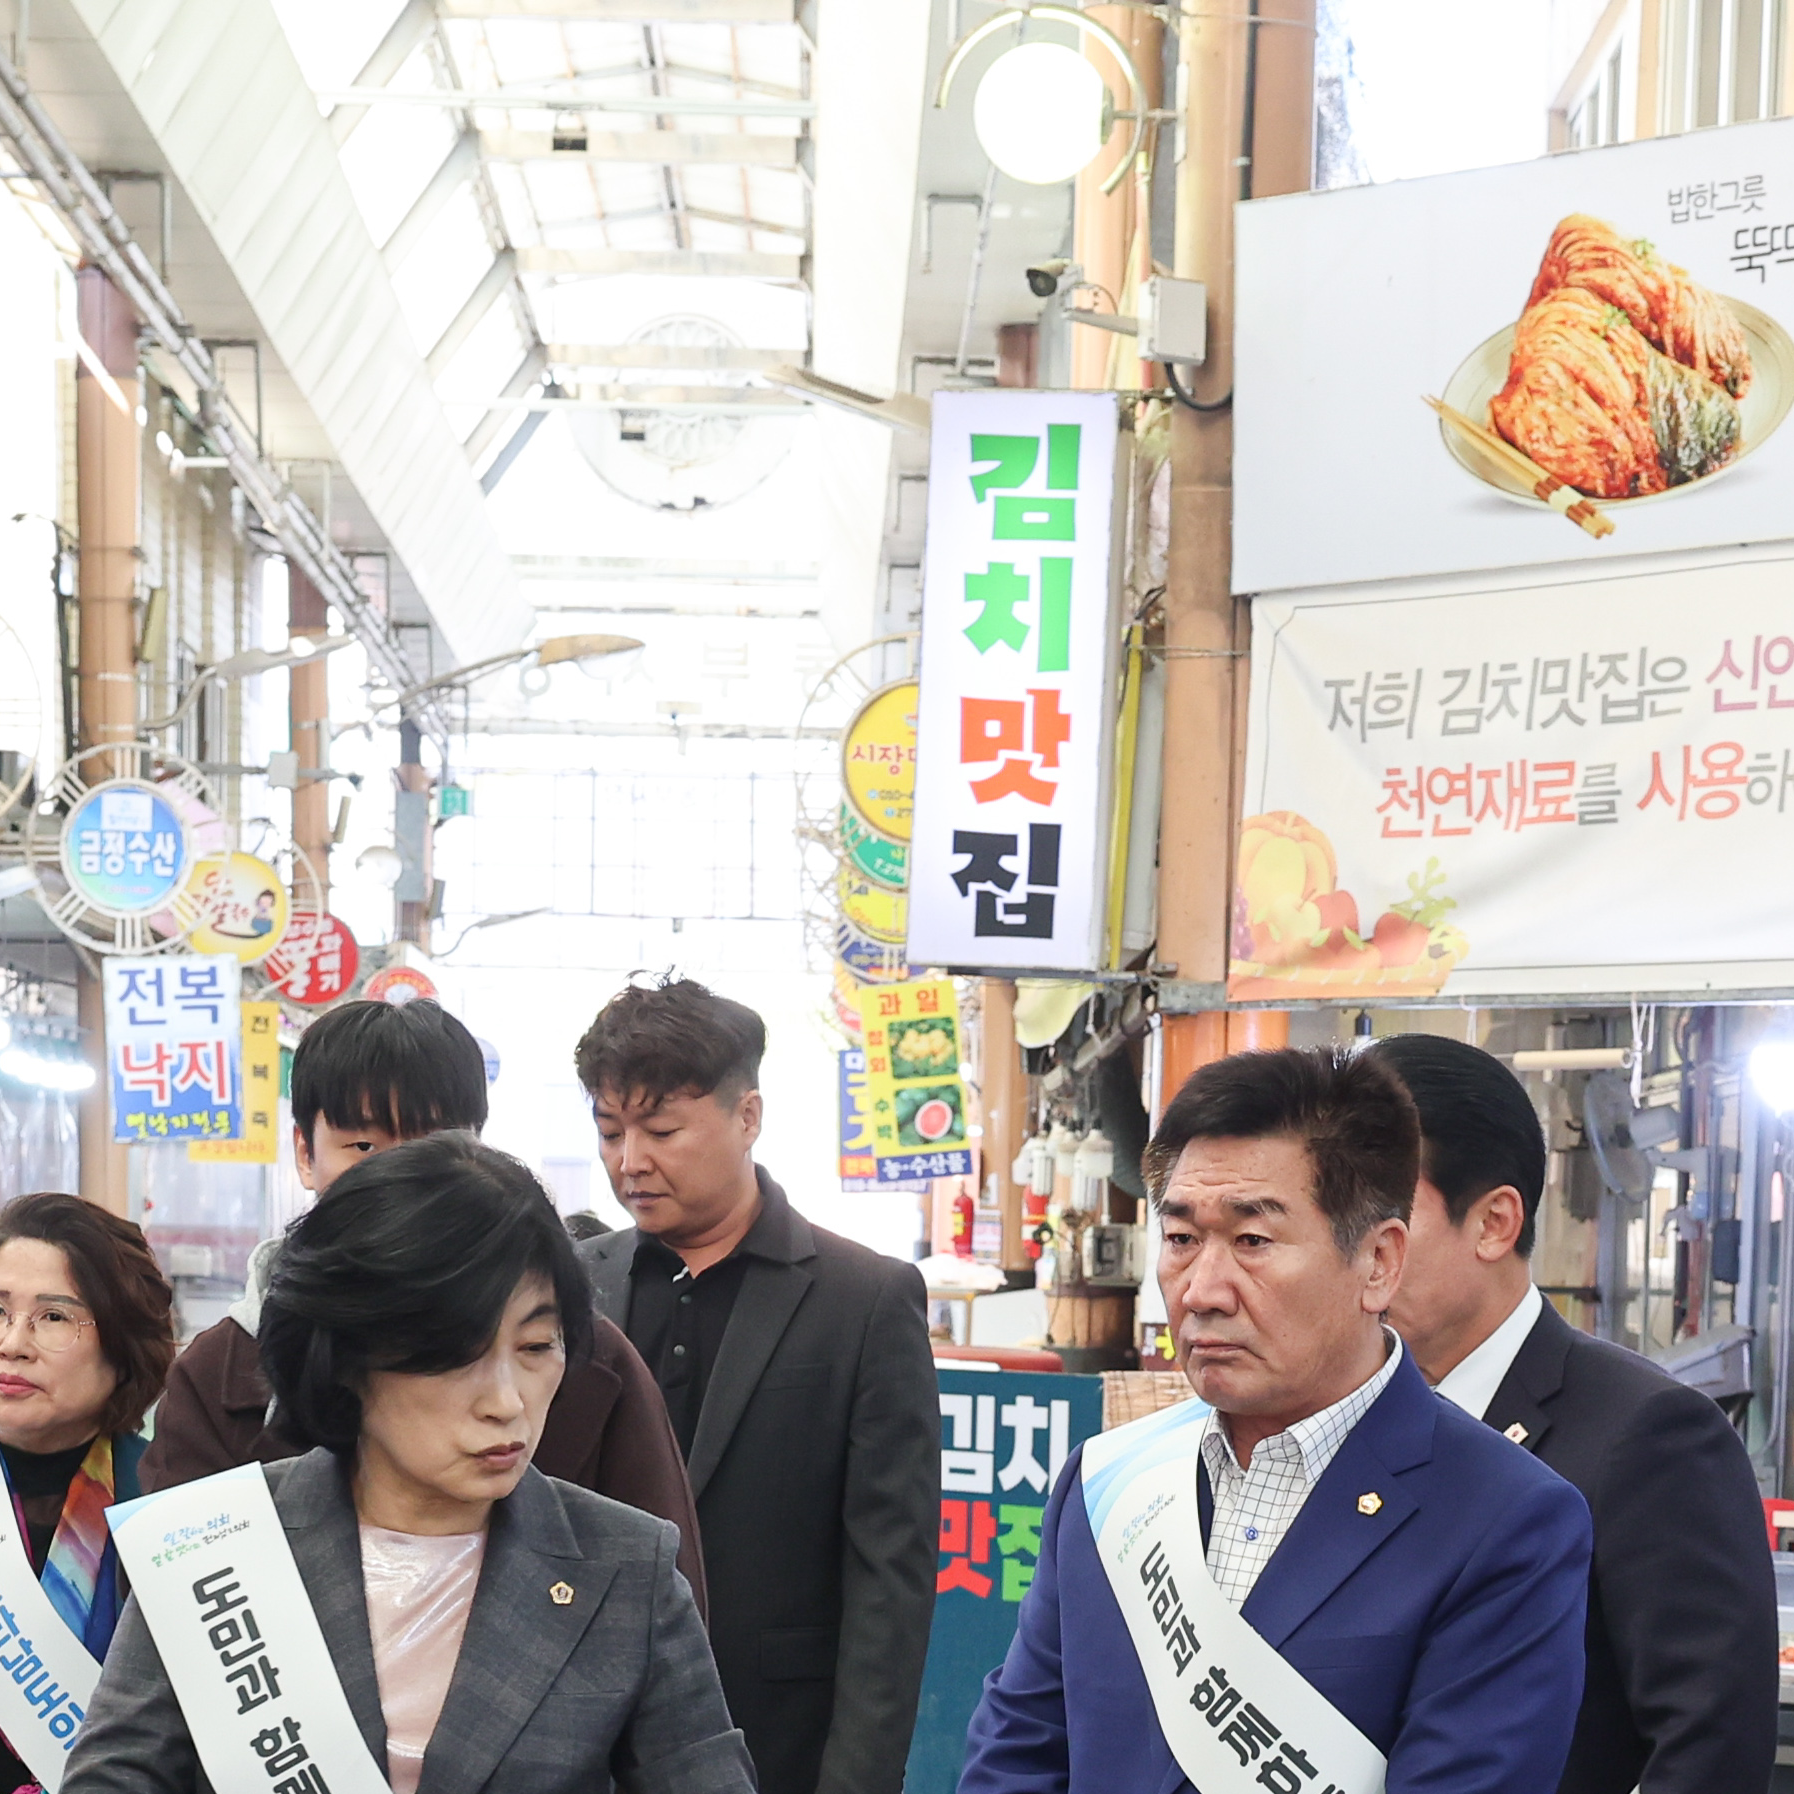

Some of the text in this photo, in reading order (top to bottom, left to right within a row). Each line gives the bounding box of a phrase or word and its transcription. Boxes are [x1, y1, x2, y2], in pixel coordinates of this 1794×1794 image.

[1667, 174, 1767, 226] 밥한그릇
[951, 422, 1082, 940] 김치맛집
[1323, 666, 1422, 744] 저희
[1438, 646, 1691, 737] 김치맛집은
[1374, 757, 1624, 839] 천연재료를
[79, 829, 177, 878] 금정수산
[118, 965, 225, 1026] 전복
[121, 1040, 231, 1105] 낙지
[940, 1394, 1068, 1494] 김치
[192, 1566, 282, 1716] 도민과
[1139, 1540, 1202, 1678] 도민과
